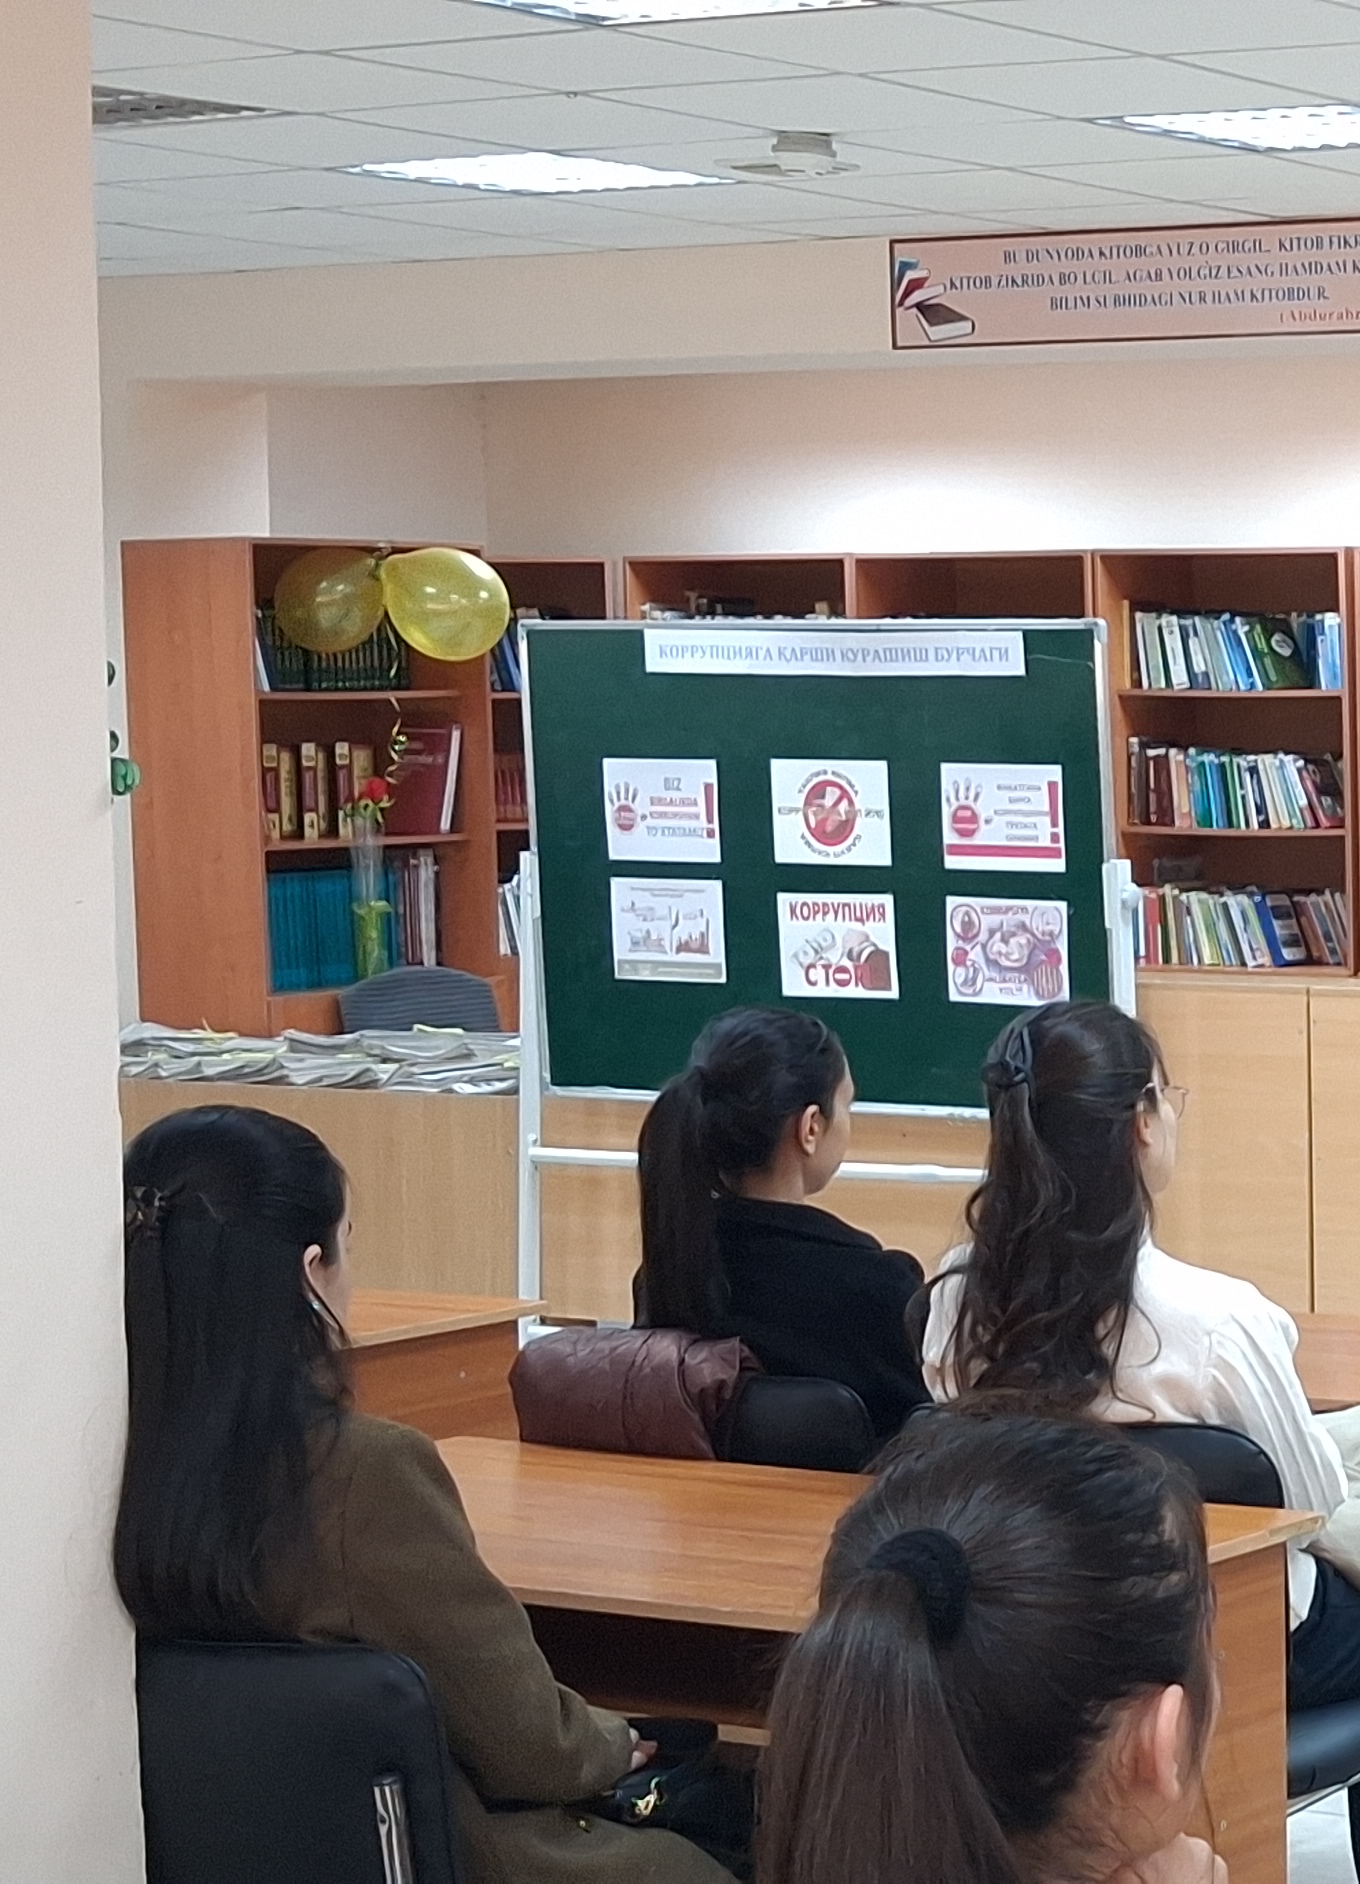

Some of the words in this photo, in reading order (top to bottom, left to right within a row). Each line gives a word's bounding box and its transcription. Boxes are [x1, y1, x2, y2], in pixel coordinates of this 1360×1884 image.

[1003, 249, 1020, 265] BU
[1026, 246, 1094, 264] DUNYODA
[1098, 243, 1163, 262] KITOBGA
[1166, 241, 1196, 258] YUZ
[1278, 235, 1324, 253] KITOB
[949, 274, 993, 292] KITOB
[1279, 259, 1348, 278] HAMDAM
[1050, 294, 1091, 311] BILIM
[1178, 290, 1207, 306] NUR
[1211, 289, 1246, 305] HAM
[659, 644, 774, 662] КОРРУПЦИЯГА
[839, 647, 929, 663] КУРАШИШ
[934, 646, 1010, 663] БУРЧАГИ
[788, 900, 886, 926] КОРРУПЦИЯ
